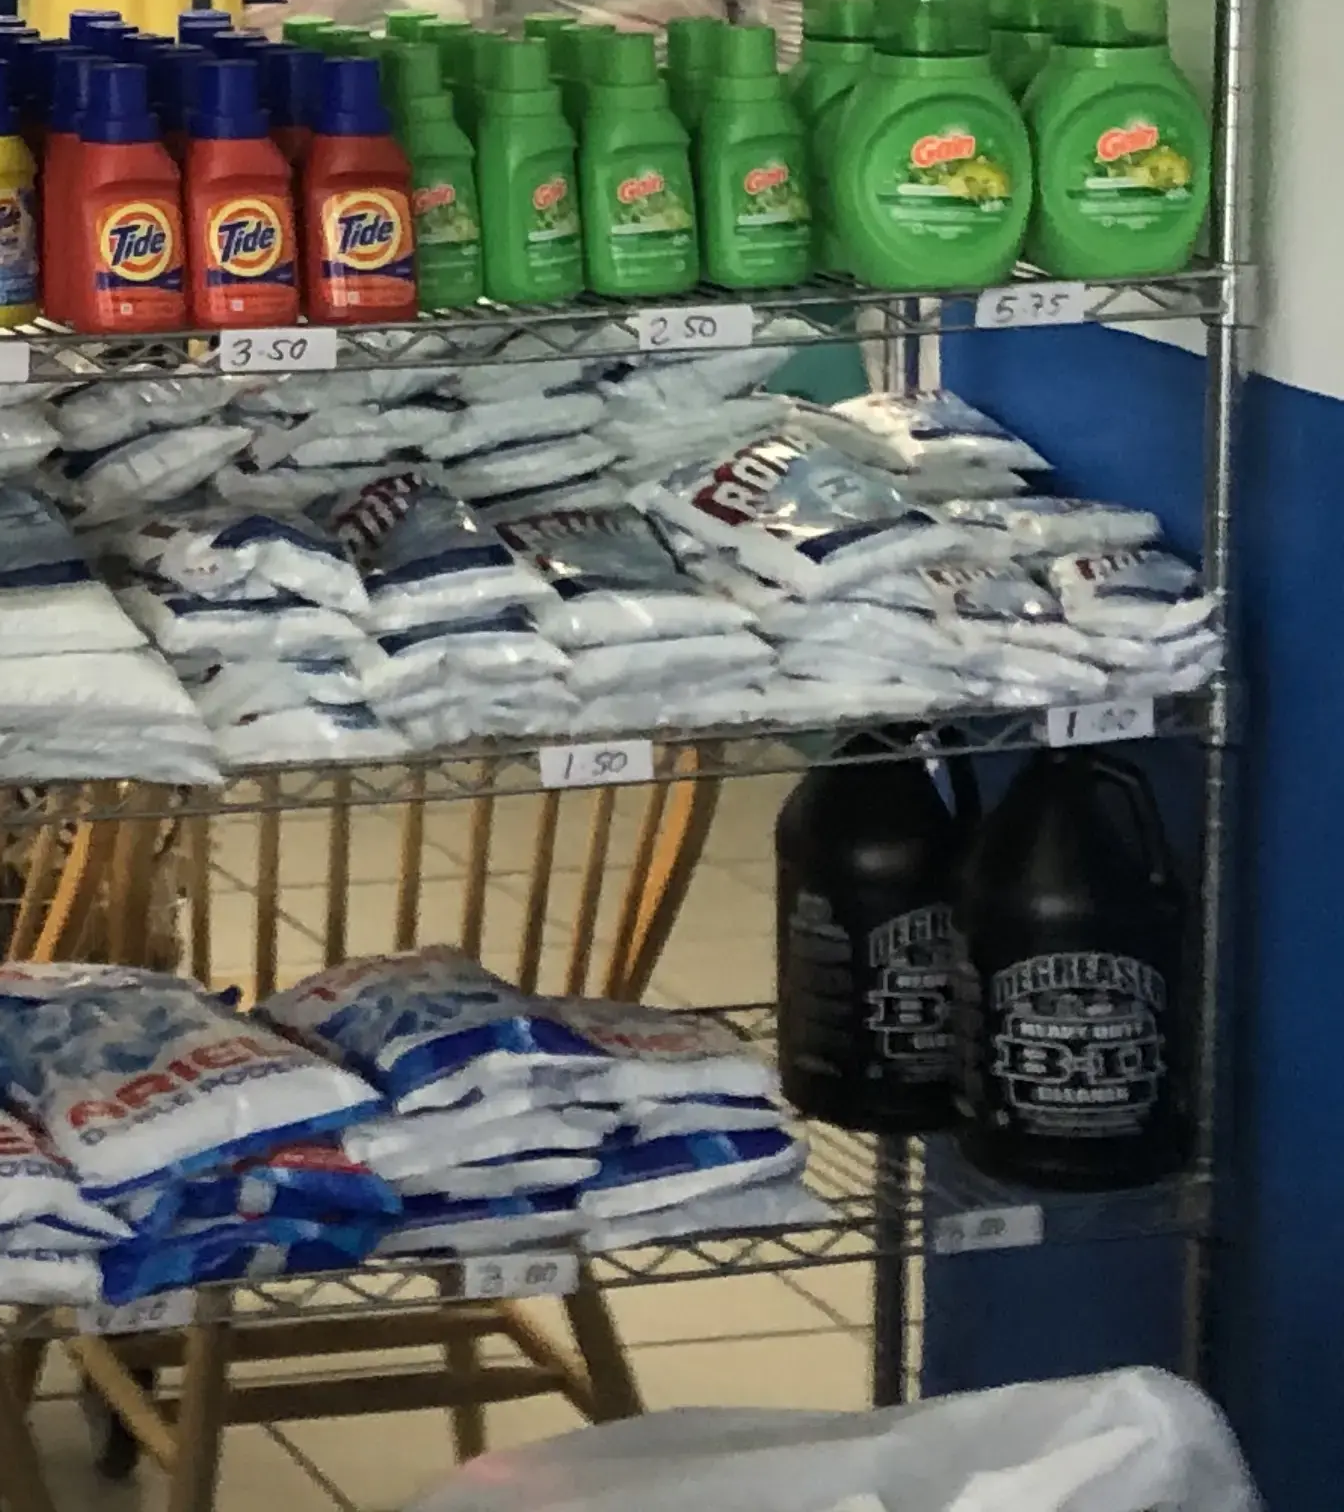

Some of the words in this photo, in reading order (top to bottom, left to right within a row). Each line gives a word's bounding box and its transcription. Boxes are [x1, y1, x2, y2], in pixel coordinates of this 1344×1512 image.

[108, 224, 167, 266] Tide
[216, 221, 276, 263] Tide
[336, 212, 396, 255] Tide
